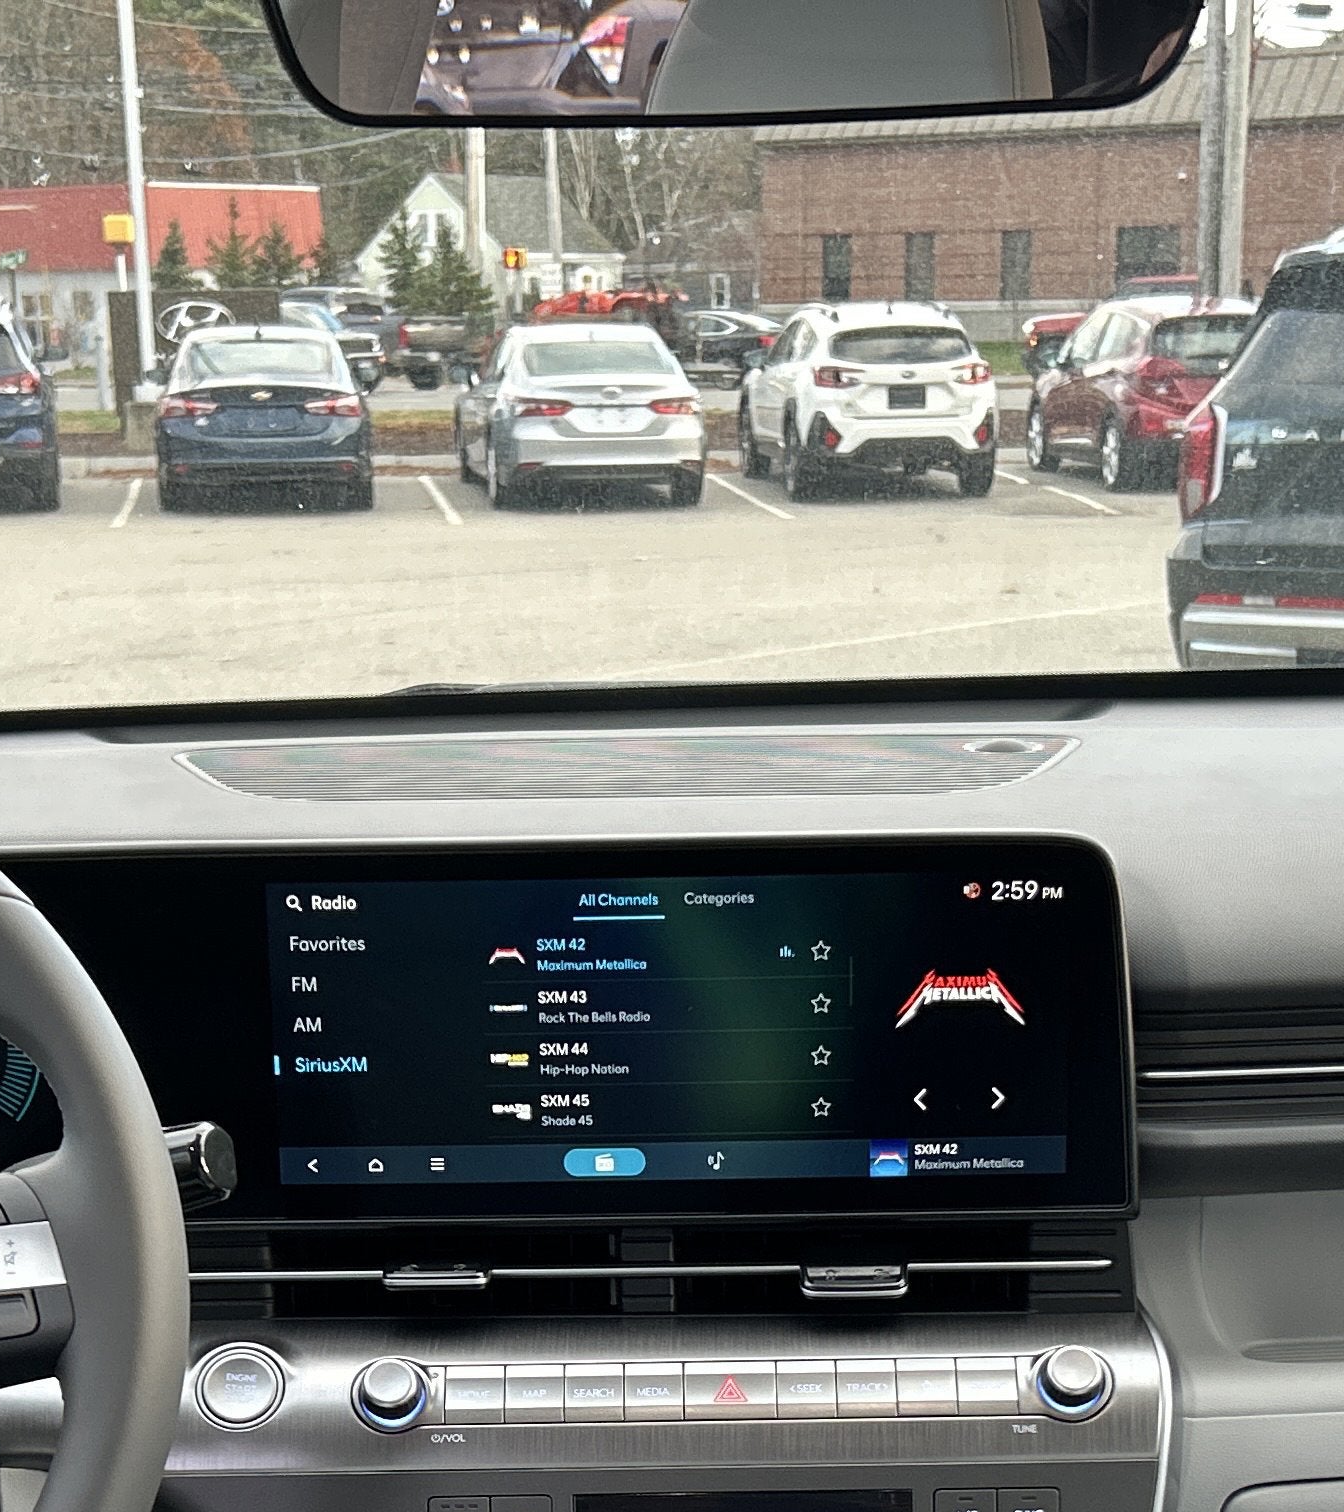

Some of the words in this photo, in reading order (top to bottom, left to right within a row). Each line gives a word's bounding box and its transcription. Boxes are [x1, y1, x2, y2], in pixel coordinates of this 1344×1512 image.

[991, 879, 1039, 901] 2:59
[1041, 886, 1063, 899] PM
[311, 894, 357, 911] Radio
[578, 893, 595, 907] All
[597, 892, 659, 906] Channels
[683, 891, 755, 907] Categories
[289, 935, 366, 952] Favorites
[536, 939, 566, 951] SXM
[568, 938, 586, 951] 42
[537, 959, 594, 971] Maximum
[595, 958, 647, 971] Metallica
[291, 976, 318, 992] FM
[537, 991, 567, 1004] SXM
[569, 990, 588, 1003] 43
[538, 1012, 566, 1024] Rock
[567, 1012, 590, 1023] The
[591, 1011, 617, 1023] Bells
[618, 1011, 651, 1023] Radio
[293, 1016, 323, 1033] AM
[539, 1043, 569, 1056] SXM
[570, 1043, 589, 1056] 44
[294, 1056, 368, 1073] SiriusXM
[540, 1064, 590, 1077] Hip-Hop
[591, 1063, 630, 1075] Nation
[540, 1094, 570, 1107] SXM
[572, 1094, 590, 1107] 45
[541, 1115, 576, 1126] Shade
[577, 1115, 594, 1126] 45
[914, 1144, 941, 1155] SXM
[941, 1143, 958, 1155] 42
[914, 1159, 971, 1170] Maximum
[972, 1158, 1024, 1169] Metallica
[522, 1388, 547, 1399] MAP
[573, 1387, 615, 1399] SEARCH
[636, 1387, 670, 1397] MEDIA
[1012, 1424, 1037, 1434] TUNE
